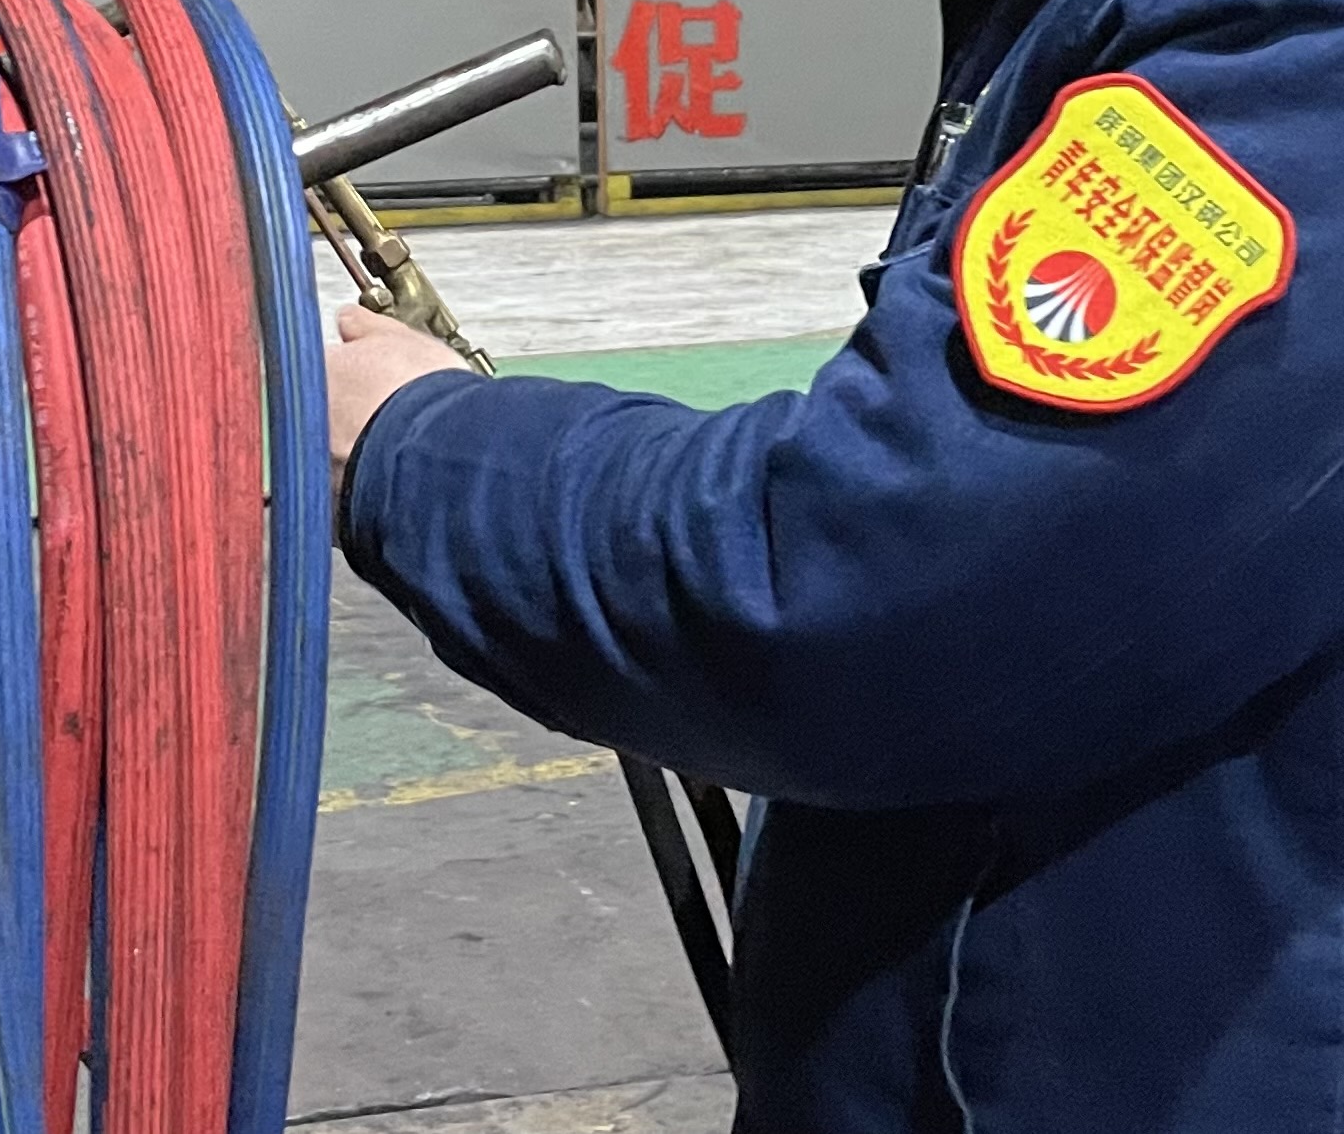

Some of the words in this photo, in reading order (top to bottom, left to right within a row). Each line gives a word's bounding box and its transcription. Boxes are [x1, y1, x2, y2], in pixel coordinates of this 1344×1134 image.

[1040, 139, 1235, 327] 青年安全环保监督岗
[1093, 105, 1267, 267] 陕钢集团汉钢公司
